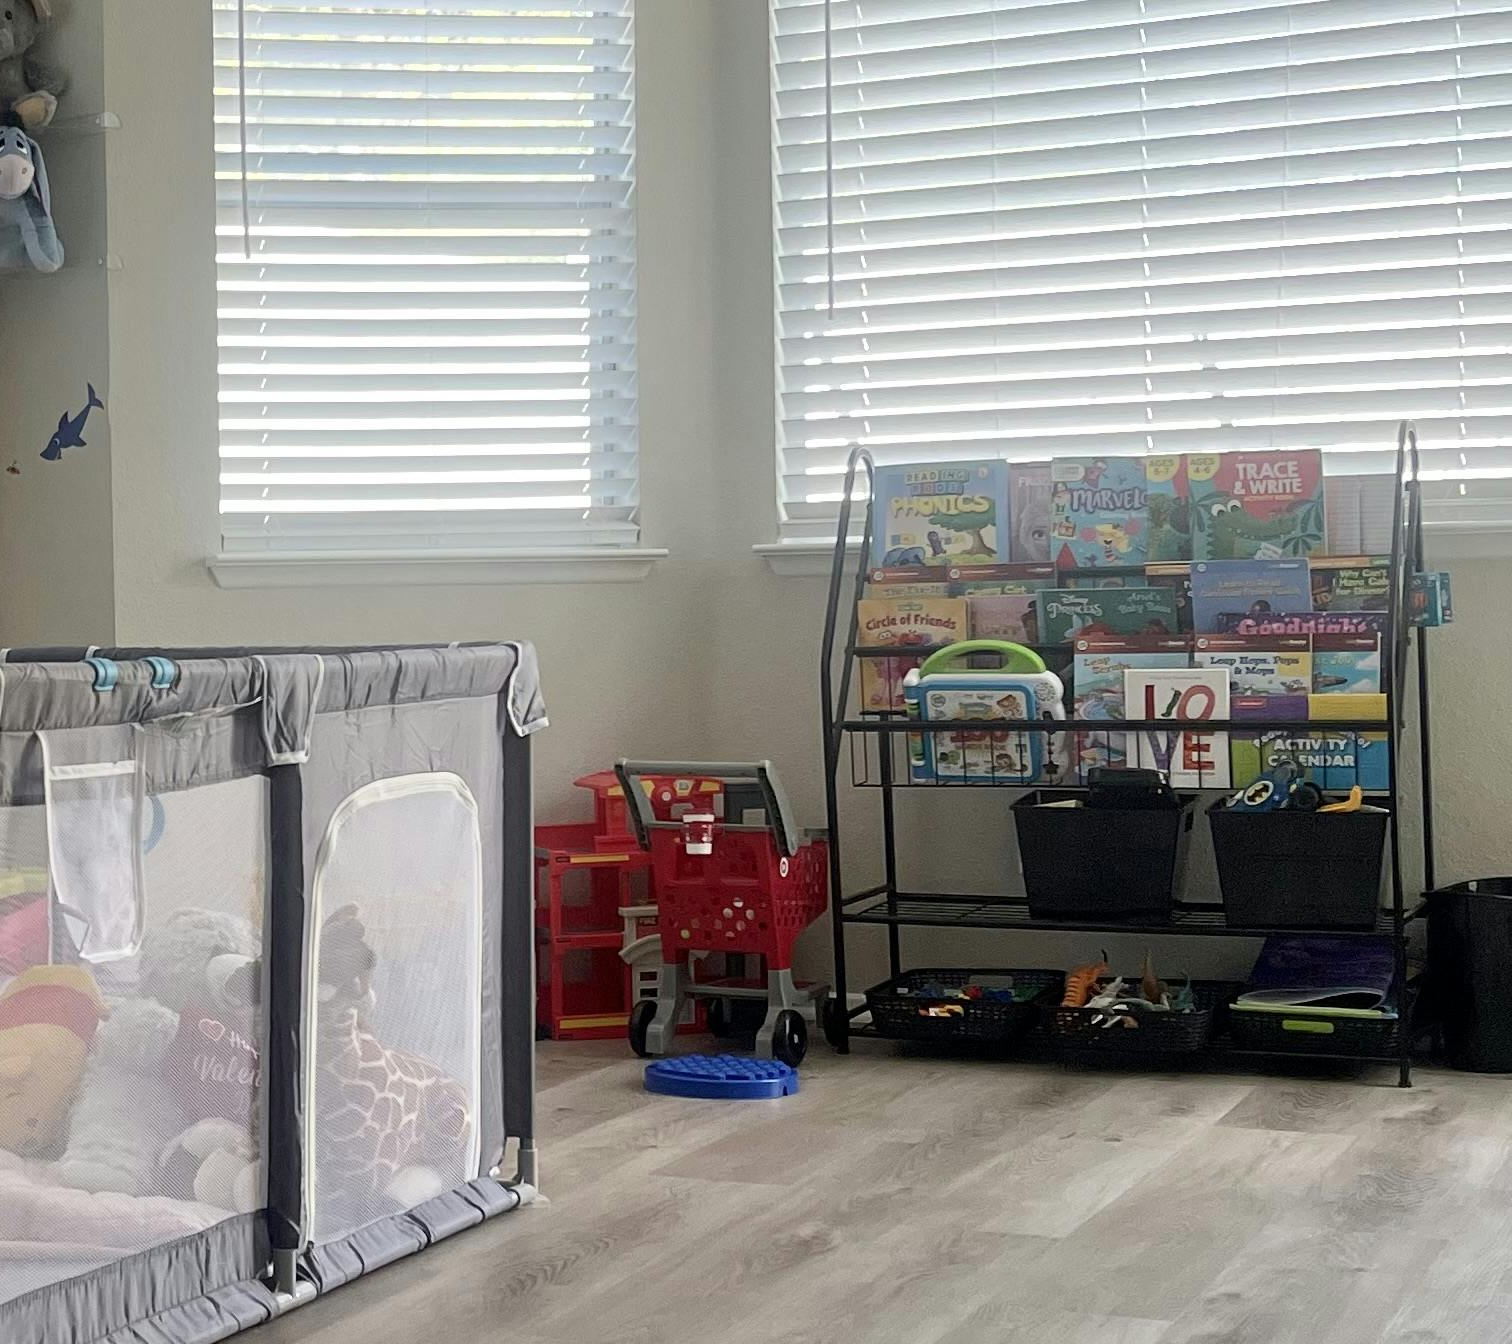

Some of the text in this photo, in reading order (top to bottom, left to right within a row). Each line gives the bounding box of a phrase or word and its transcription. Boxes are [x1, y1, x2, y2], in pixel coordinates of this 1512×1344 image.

[1235, 460, 1299, 480] TRACE
[1233, 478, 1303, 495] & WRITE
[891, 496, 990, 517] PHONICS
[866, 614, 957, 631] Circle of Friends
[1274, 738, 1348, 751] ACTIVTY
